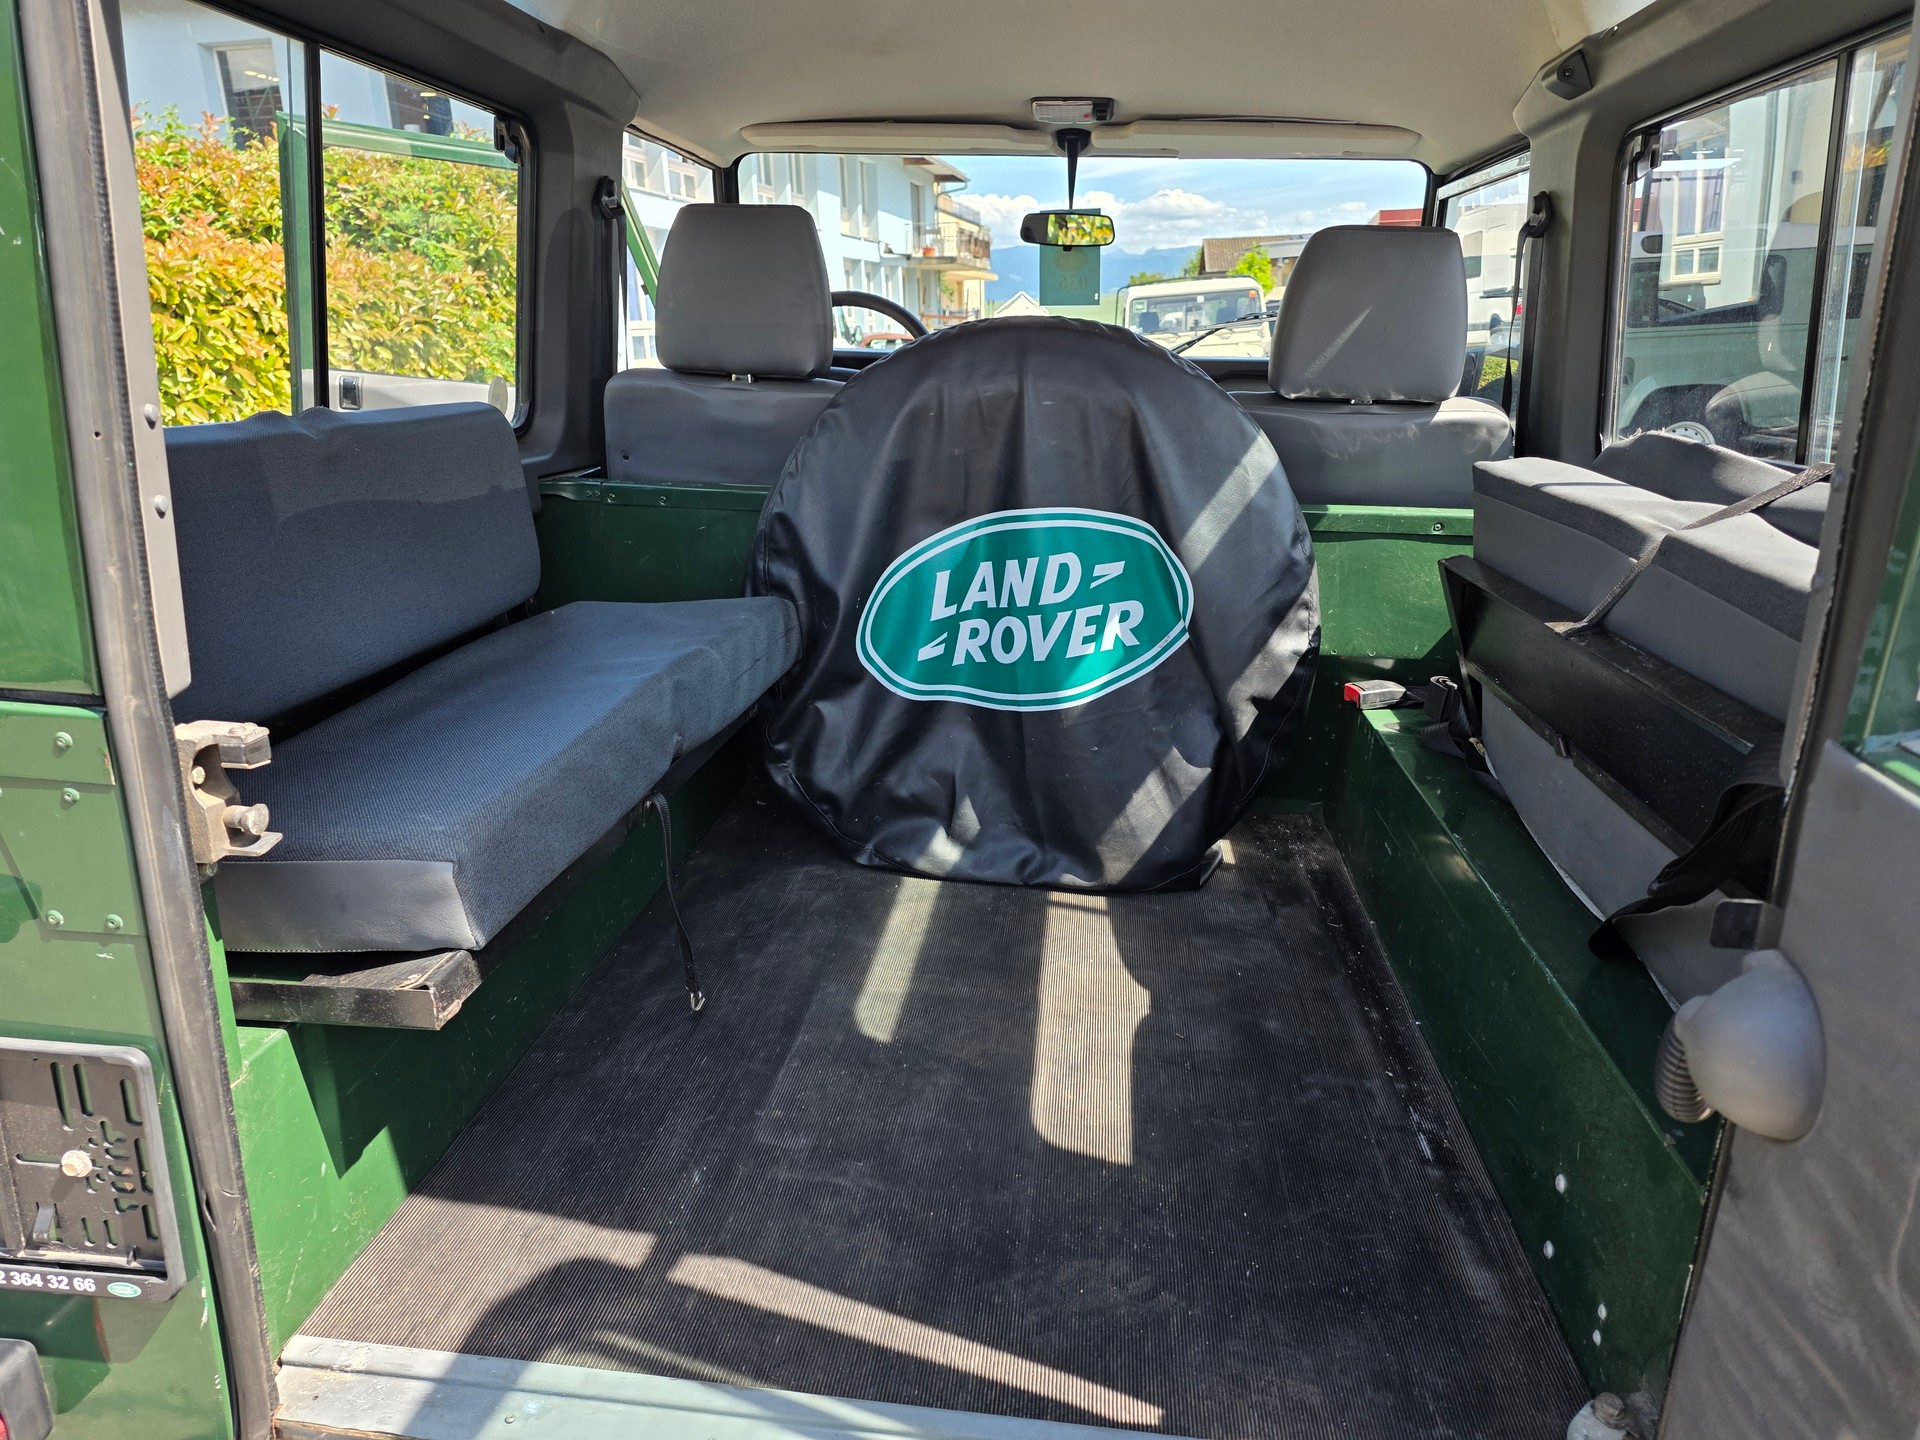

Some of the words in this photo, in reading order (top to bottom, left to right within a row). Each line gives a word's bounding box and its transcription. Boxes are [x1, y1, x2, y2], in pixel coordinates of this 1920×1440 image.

[930, 551, 1082, 622] LAND
[951, 599, 1144, 667] ROVER
[9, 1271, 44, 1287] 364
[46, 1274, 70, 1290] 32
[73, 1277, 96, 1292] 66
